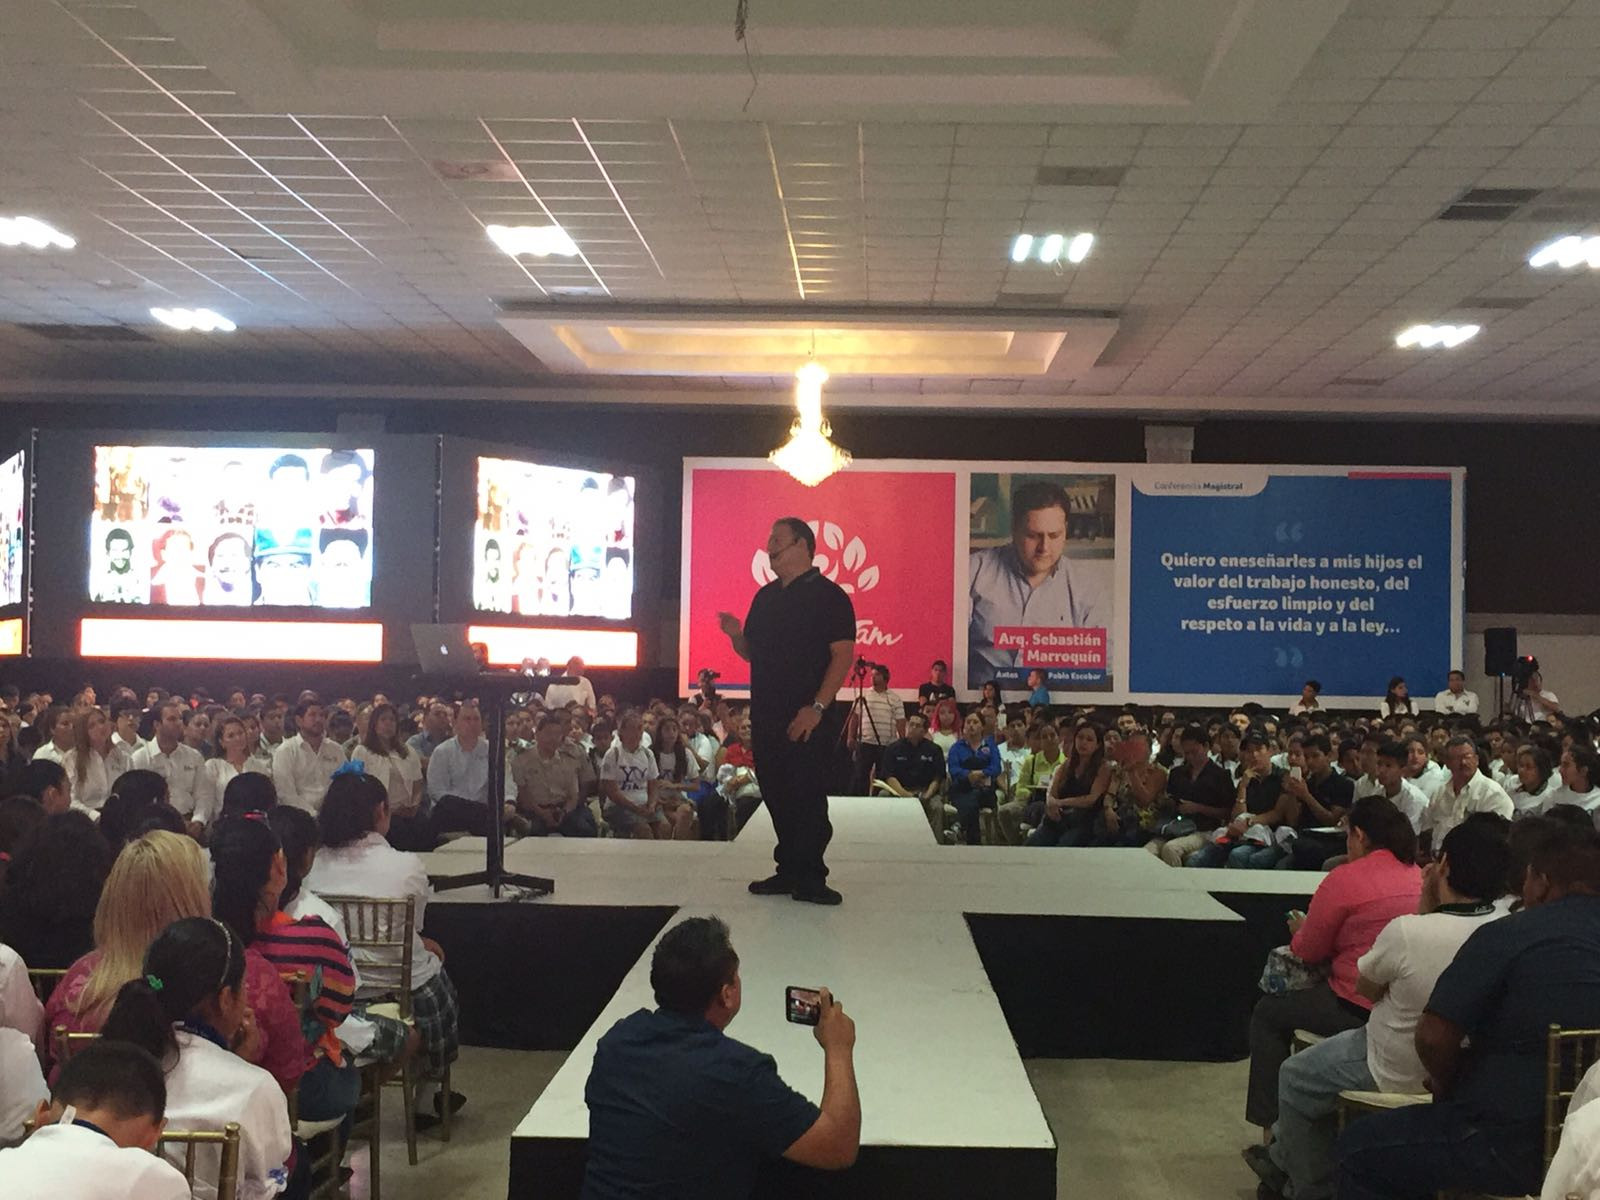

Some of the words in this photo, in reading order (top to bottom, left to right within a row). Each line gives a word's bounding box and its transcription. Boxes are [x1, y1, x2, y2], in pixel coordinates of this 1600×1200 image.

[1203, 482, 1243, 492] Magistral
[1161, 552, 1216, 571] Quiero
[1219, 553, 1315, 568] eneseñarles
[1320, 557, 1329, 568] a
[1333, 554, 1361, 569] mis
[1365, 554, 1404, 572] hijos
[1407, 554, 1423, 569] el
[1173, 574, 1215, 588] valor
[1218, 574, 1243, 589] del
[1247, 574, 1306, 593] trabajo
[1310, 575, 1380, 592] honesto,
[1384, 576, 1410, 590] del
[1207, 595, 1278, 610] esfuerzo
[1282, 596, 1333, 614] limpio
[1336, 600, 1345, 614] y
[1349, 597, 1375, 611] del
[1181, 617, 1243, 634] respeto
[1246, 620, 1256, 631] a
[1260, 617, 1274, 631] la
[1278, 617, 1312, 632] vida
[1316, 621, 1325, 636] y
[1329, 621, 1339, 632] a
[1342, 618, 1357, 632] la
[1361, 618, 1400, 636] ley...
[998, 632, 1028, 648] Arq.
[1032, 633, 1101, 646] Sebastián
[1027, 650, 1101, 665] Marroquín
[1048, 672, 1070, 680] Pablo
[1071, 672, 1102, 680] Escobar
